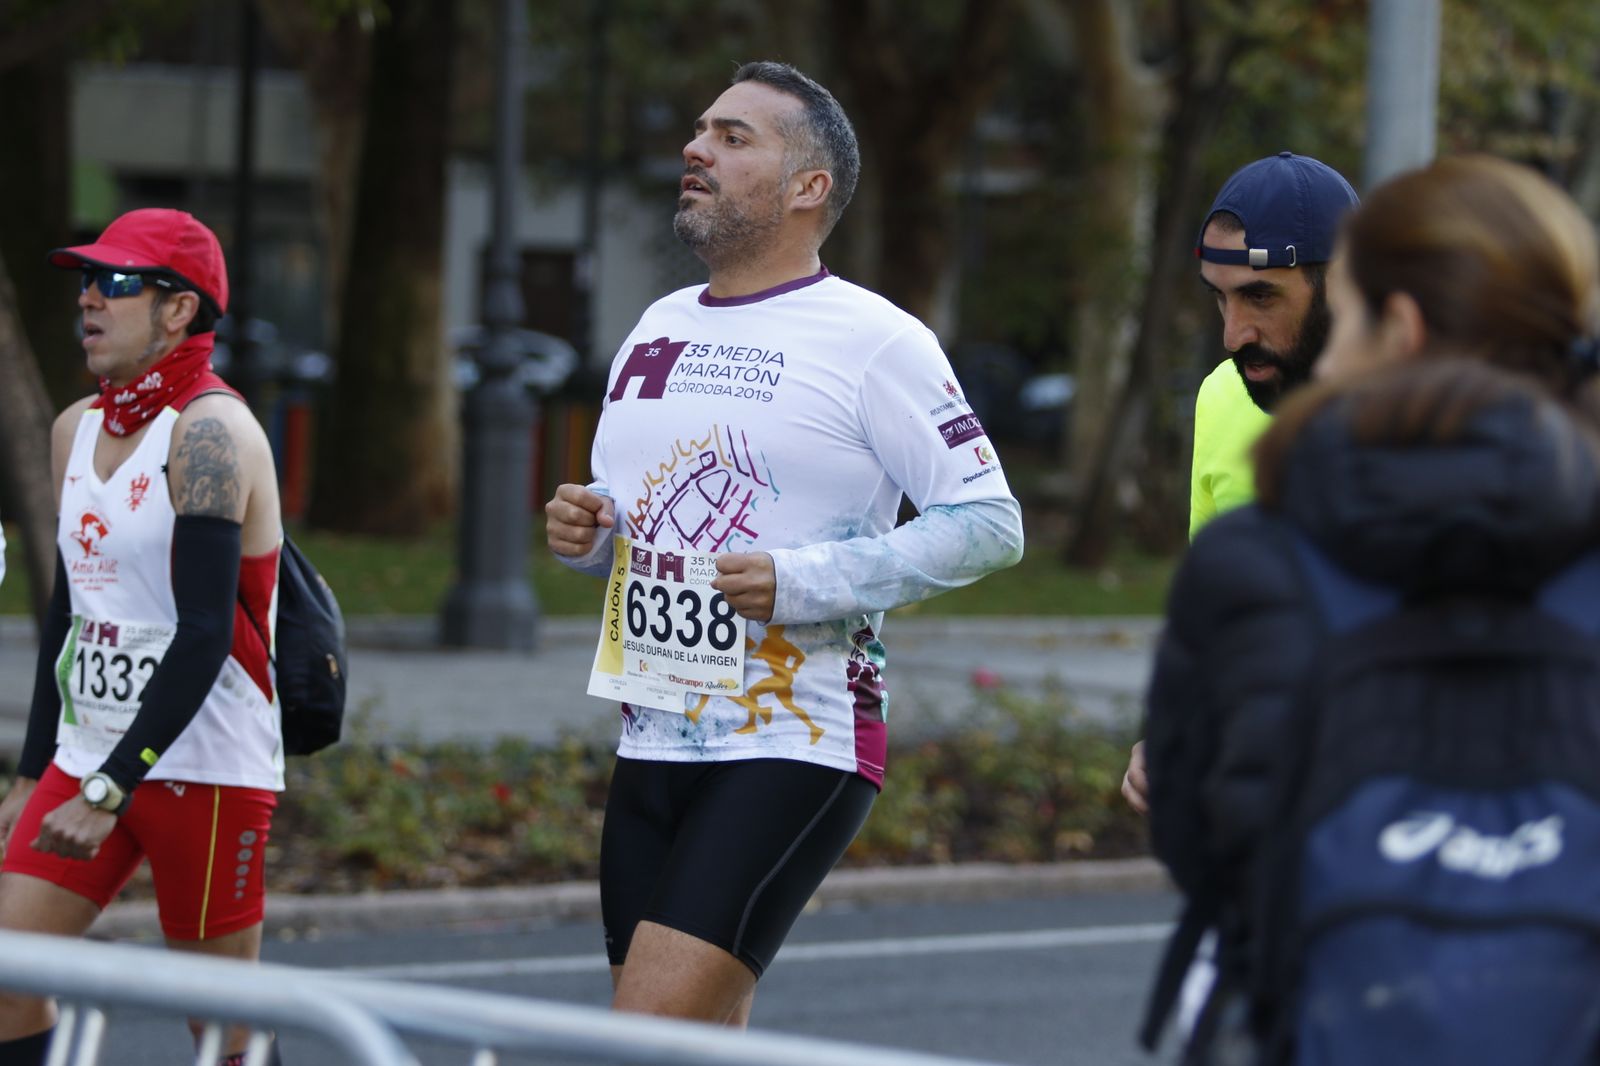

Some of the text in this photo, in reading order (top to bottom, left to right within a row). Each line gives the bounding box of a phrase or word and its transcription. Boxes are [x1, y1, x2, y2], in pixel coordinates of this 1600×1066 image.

[645, 347, 661, 357] 35
[684, 344, 785, 368] 35 MEDIA
[674, 362, 781, 387] MARATÓN
[690, 556, 705, 566] 35
[610, 566, 625, 642] CAJÓN 5
[627, 580, 738, 651] 6338
[622, 640, 737, 667] JESUS DURAN DE LA VIRGEN
